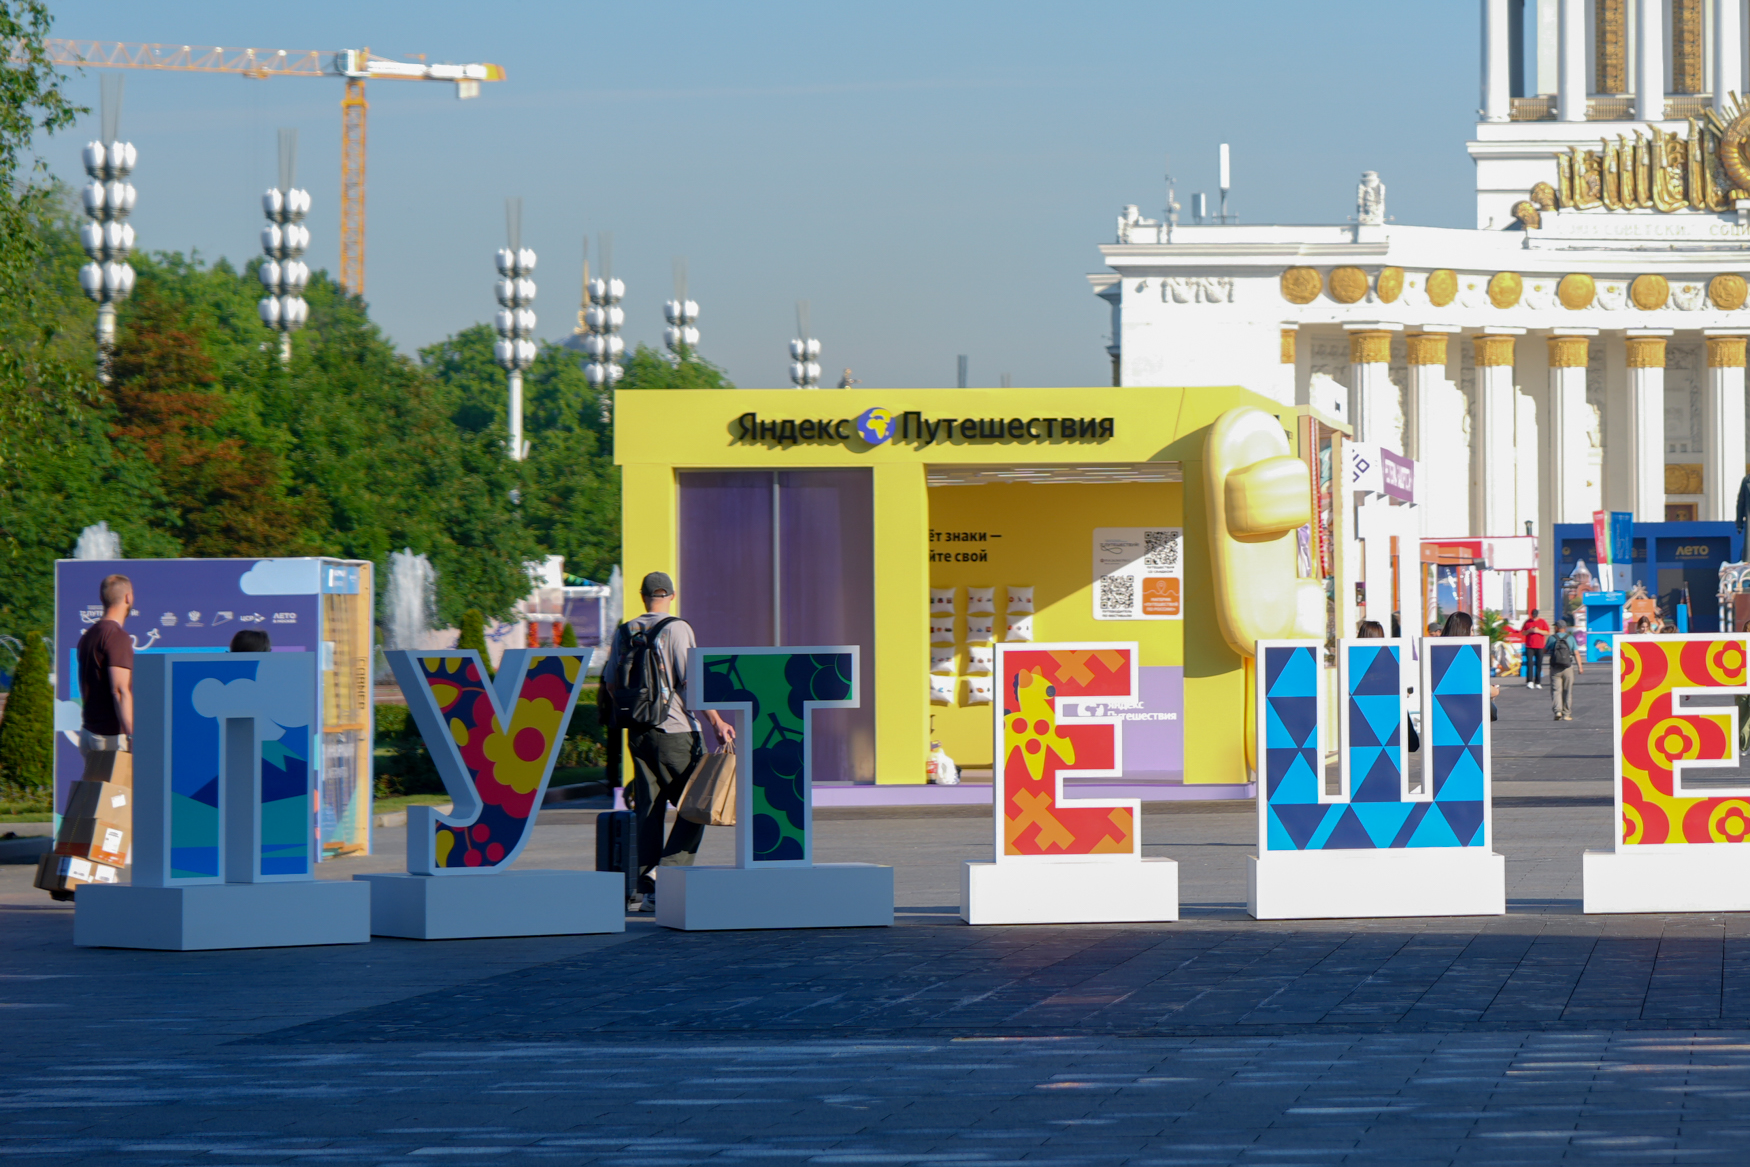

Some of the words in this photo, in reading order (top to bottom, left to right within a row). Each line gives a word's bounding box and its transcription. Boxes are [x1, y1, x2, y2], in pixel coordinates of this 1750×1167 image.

[738, 412, 850, 445] Яндекс
[902, 411, 1114, 444] Путешествия
[945, 532, 987, 542] знаки
[955, 549, 988, 562] свой
